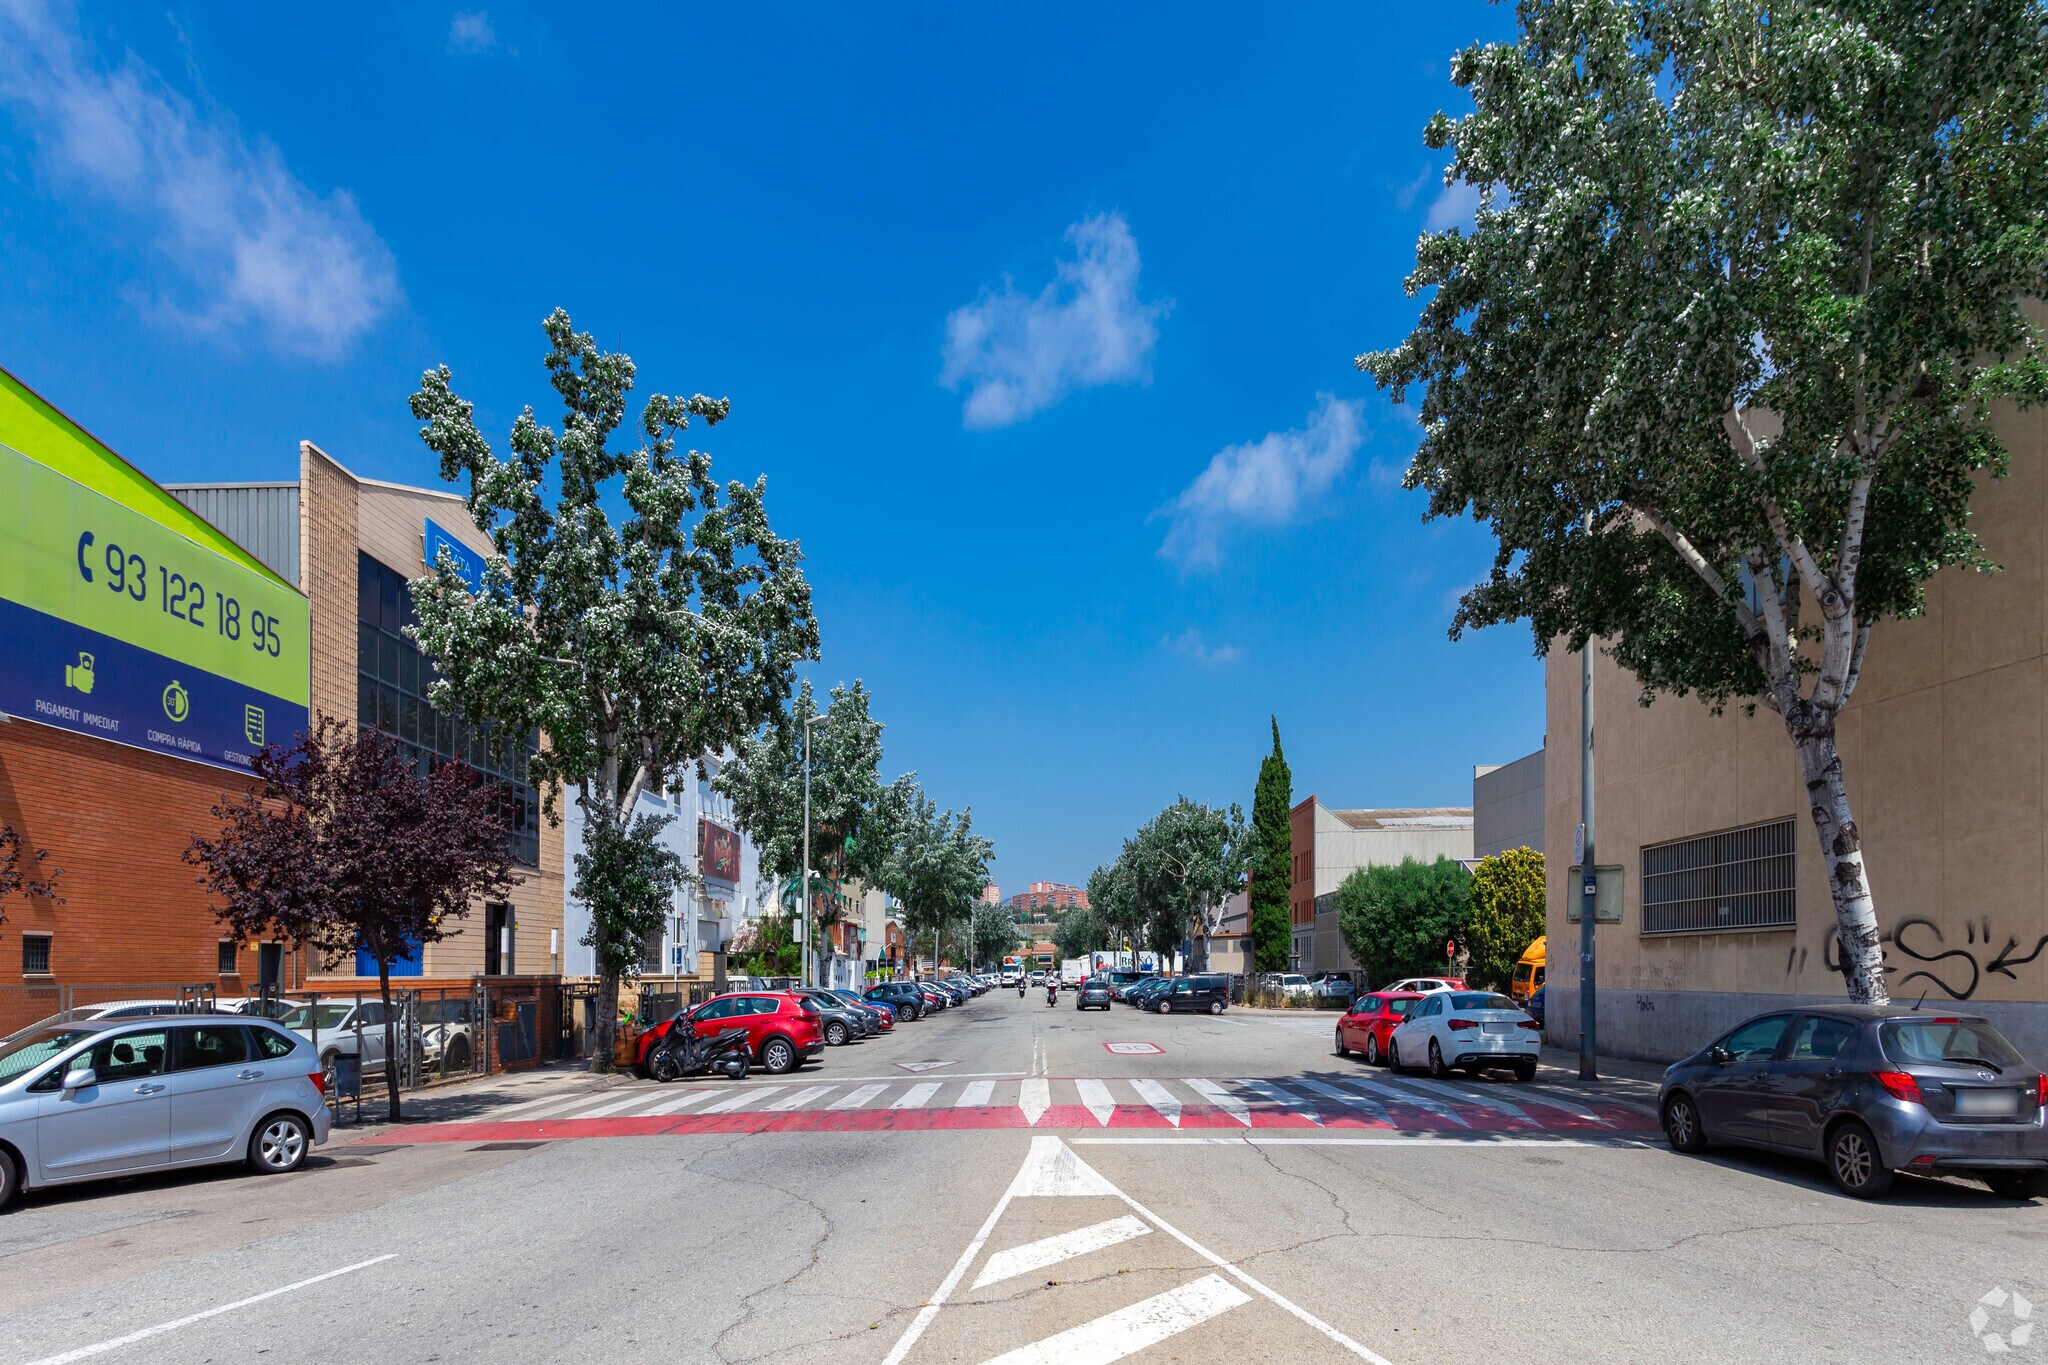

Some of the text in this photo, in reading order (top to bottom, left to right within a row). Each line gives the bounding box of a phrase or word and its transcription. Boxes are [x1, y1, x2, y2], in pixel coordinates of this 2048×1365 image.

[106, 543, 281, 658] 93 122 18 95
[35, 699, 120, 732] PAGAMENT IMMEDIAT
[147, 729, 202, 754] COMPRA RÀPIDA
